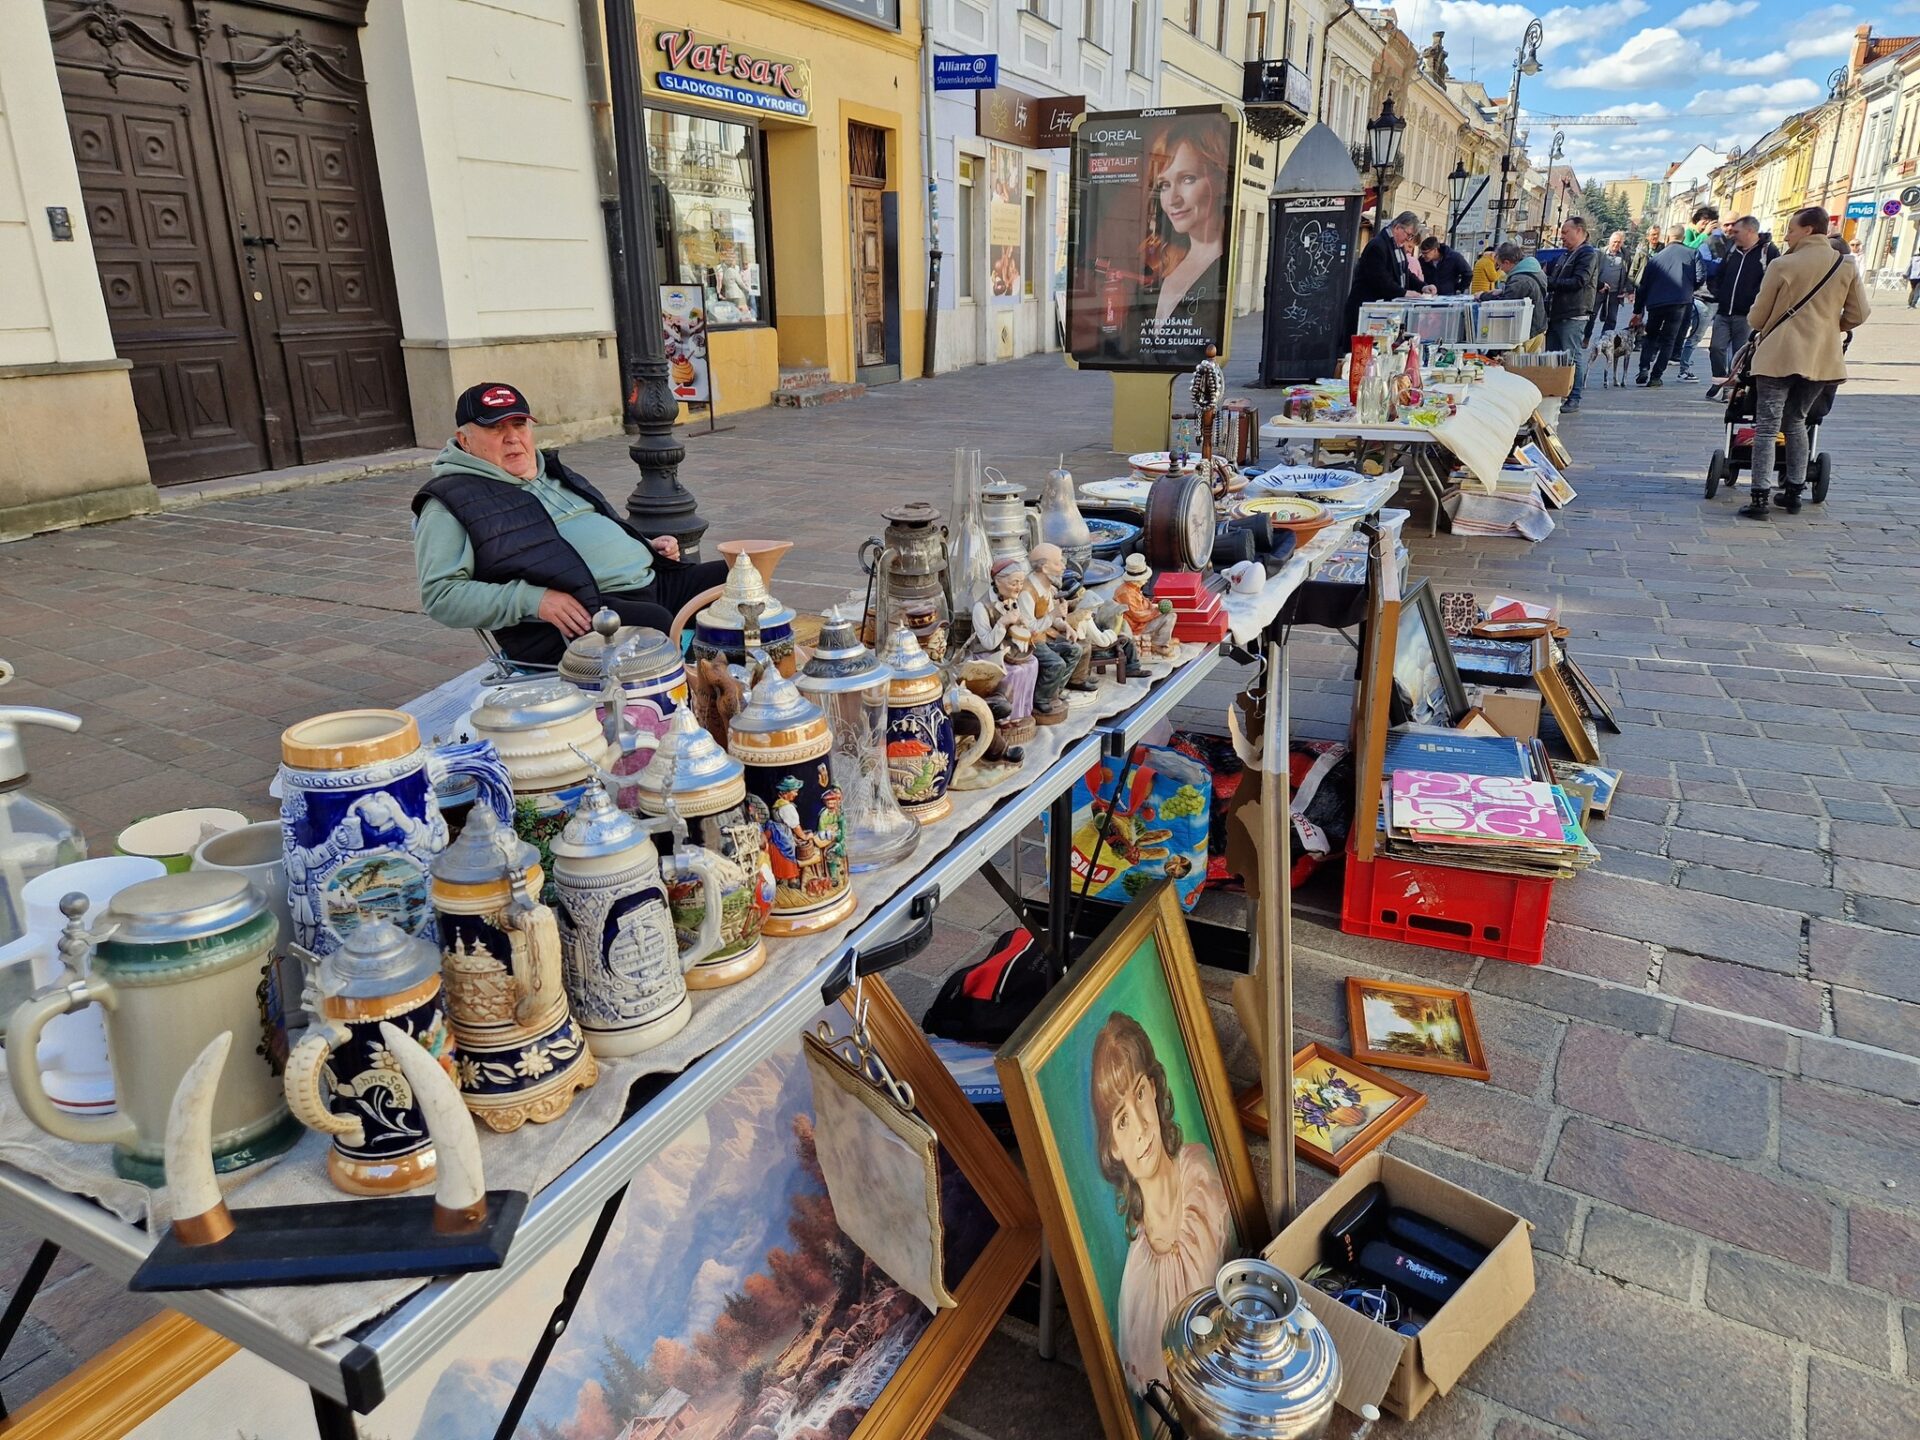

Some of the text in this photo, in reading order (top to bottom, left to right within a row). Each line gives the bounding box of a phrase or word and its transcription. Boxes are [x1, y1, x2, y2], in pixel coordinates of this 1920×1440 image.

[937, 61, 972, 71] Allianz
[665, 76, 806, 115] SLADKOSTI OD VÝROBCU
[1139, 109, 1177, 118] JCDecaux
[1089, 129, 1142, 143] L'ORÉAL
[1091, 157, 1138, 168] REVITALIFT
[1848, 204, 1873, 215] invia
[1148, 328, 1181, 336] NAOZAJ
[1183, 327, 1202, 336] PLNÍ
[1140, 338, 1153, 346] TO,
[1154, 336, 1166, 345] ČO
[1292, 812, 1313, 839] TESCO
[357, 1074, 408, 1107] ohne Sorge
[962, 1087, 1003, 1095] CULA
